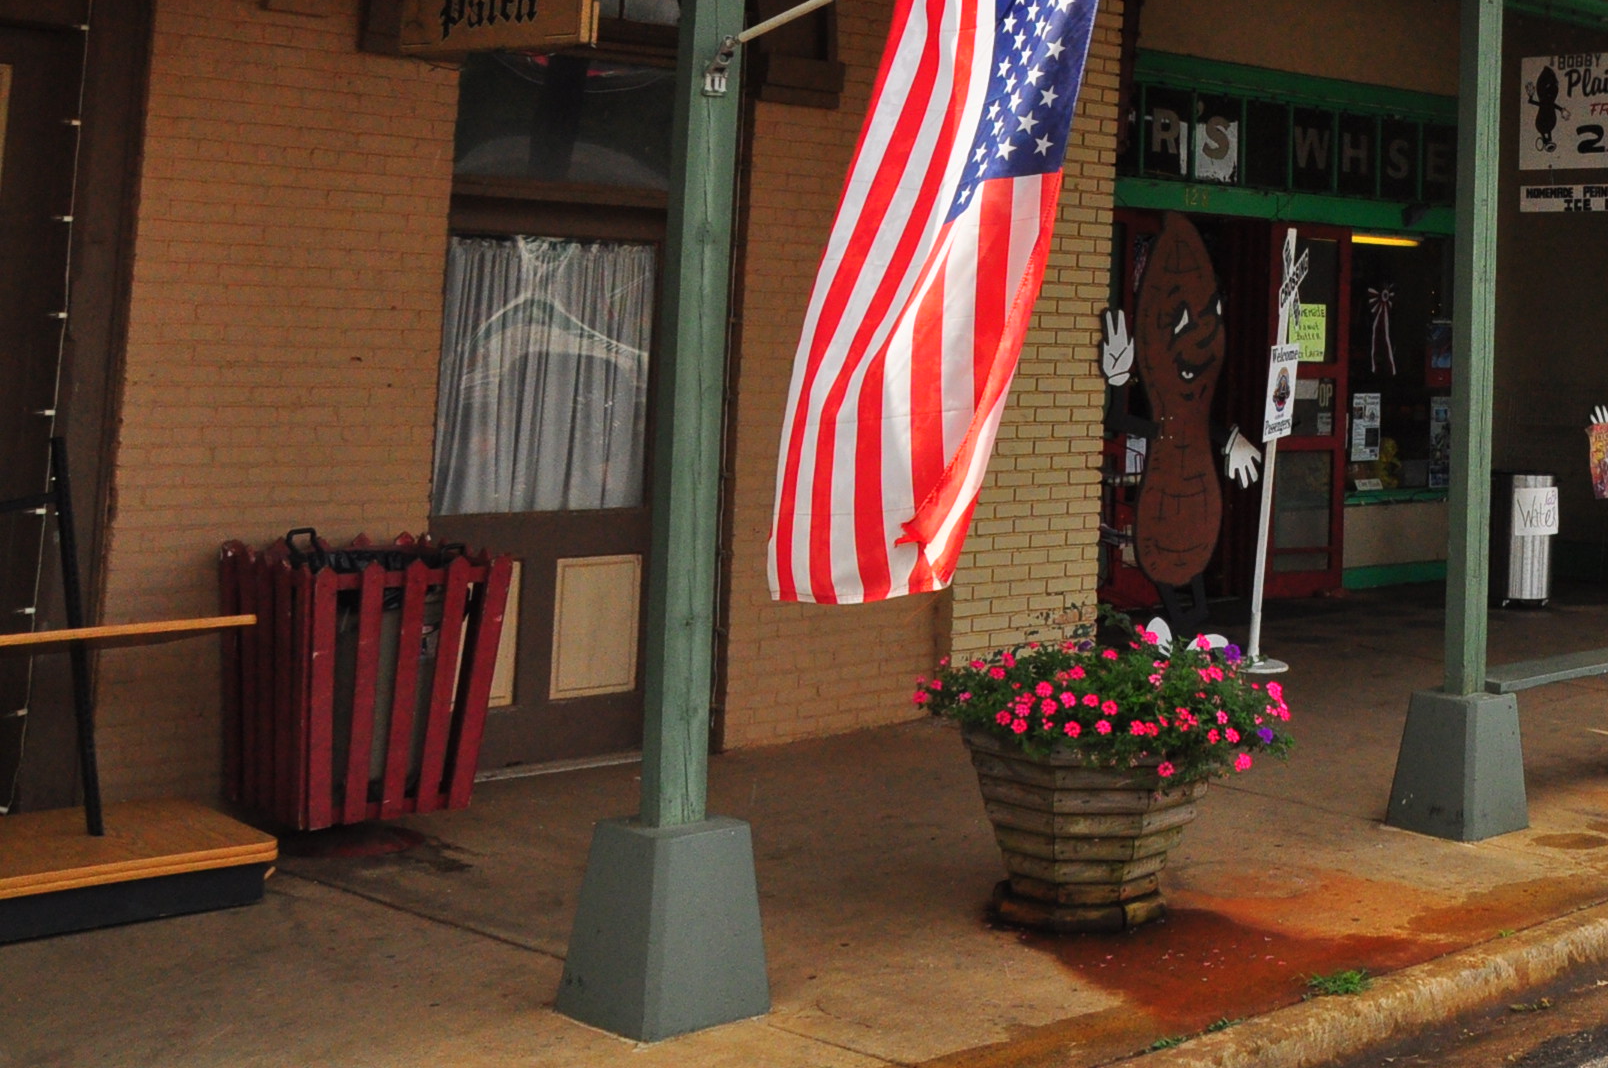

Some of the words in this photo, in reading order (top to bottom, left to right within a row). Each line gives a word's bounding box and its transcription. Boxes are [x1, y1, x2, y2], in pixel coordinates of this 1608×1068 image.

[1557, 53, 1601, 71] BOBBY
[1293, 124, 1449, 181] WHSE
[1525, 187, 1574, 200] HOMEMADE
[1563, 199, 1592, 212] ICE
[1272, 347, 1299, 364] Welcome
